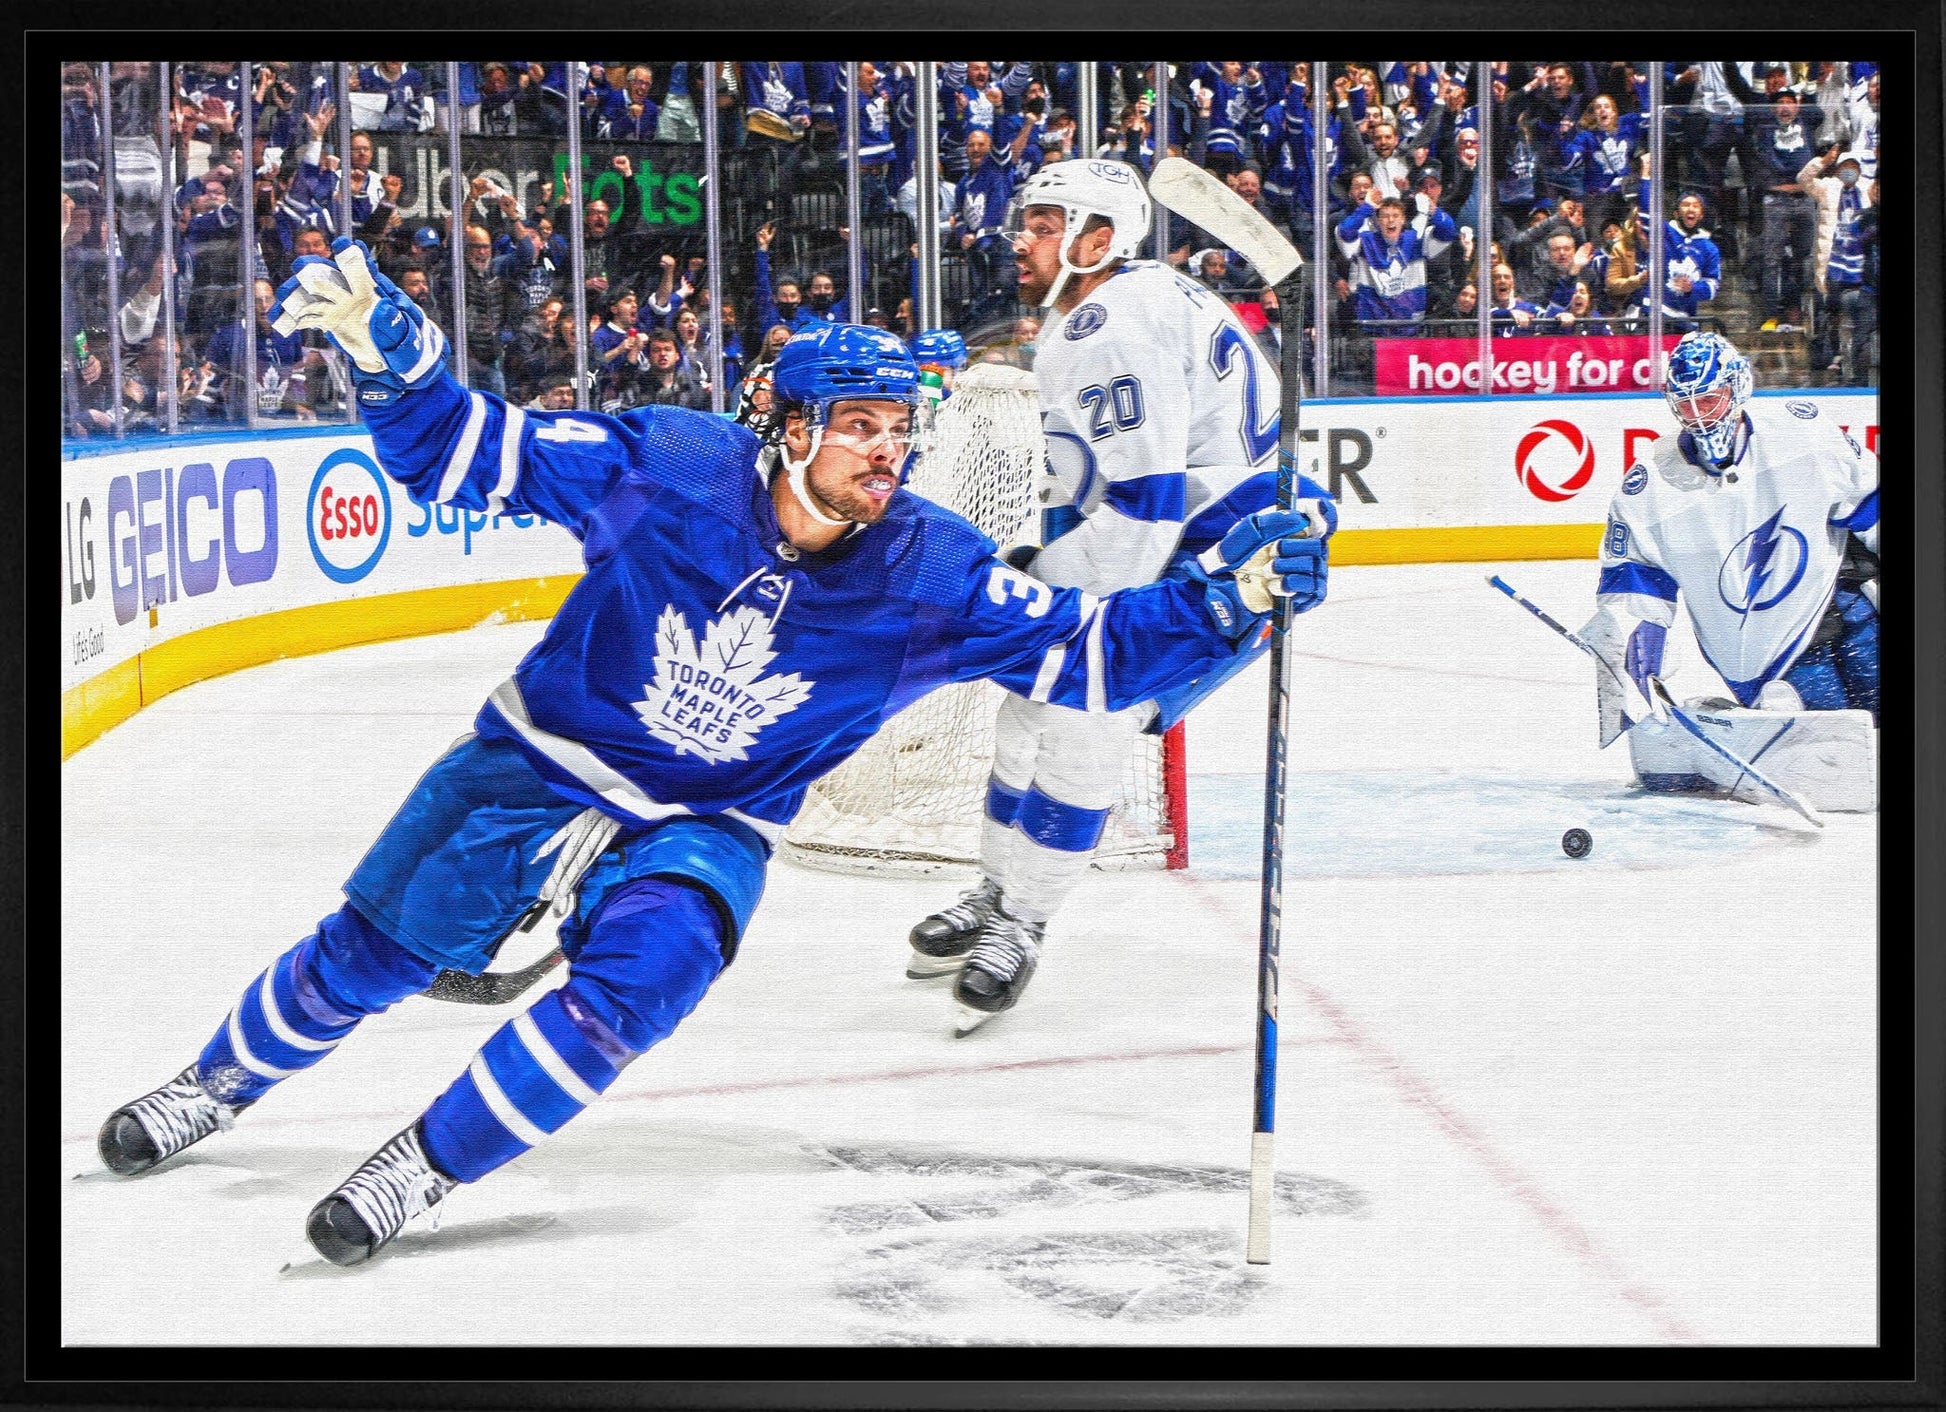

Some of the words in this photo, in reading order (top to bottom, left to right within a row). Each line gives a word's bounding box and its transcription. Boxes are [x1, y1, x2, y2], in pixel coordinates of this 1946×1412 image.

[875, 367, 915, 380] CCM
[1408, 354, 1557, 394] hockey
[1566, 351, 1624, 387] for
[535, 417, 608, 443] 4
[1078, 373, 1146, 443] 20
[66, 496, 96, 605] LG
[107, 456, 280, 627] GEICO
[985, 566, 1052, 619] 3
[667, 659, 766, 720] TORONTO
[669, 683, 742, 729] MAPLE
[660, 700, 733, 744] LEAFS
